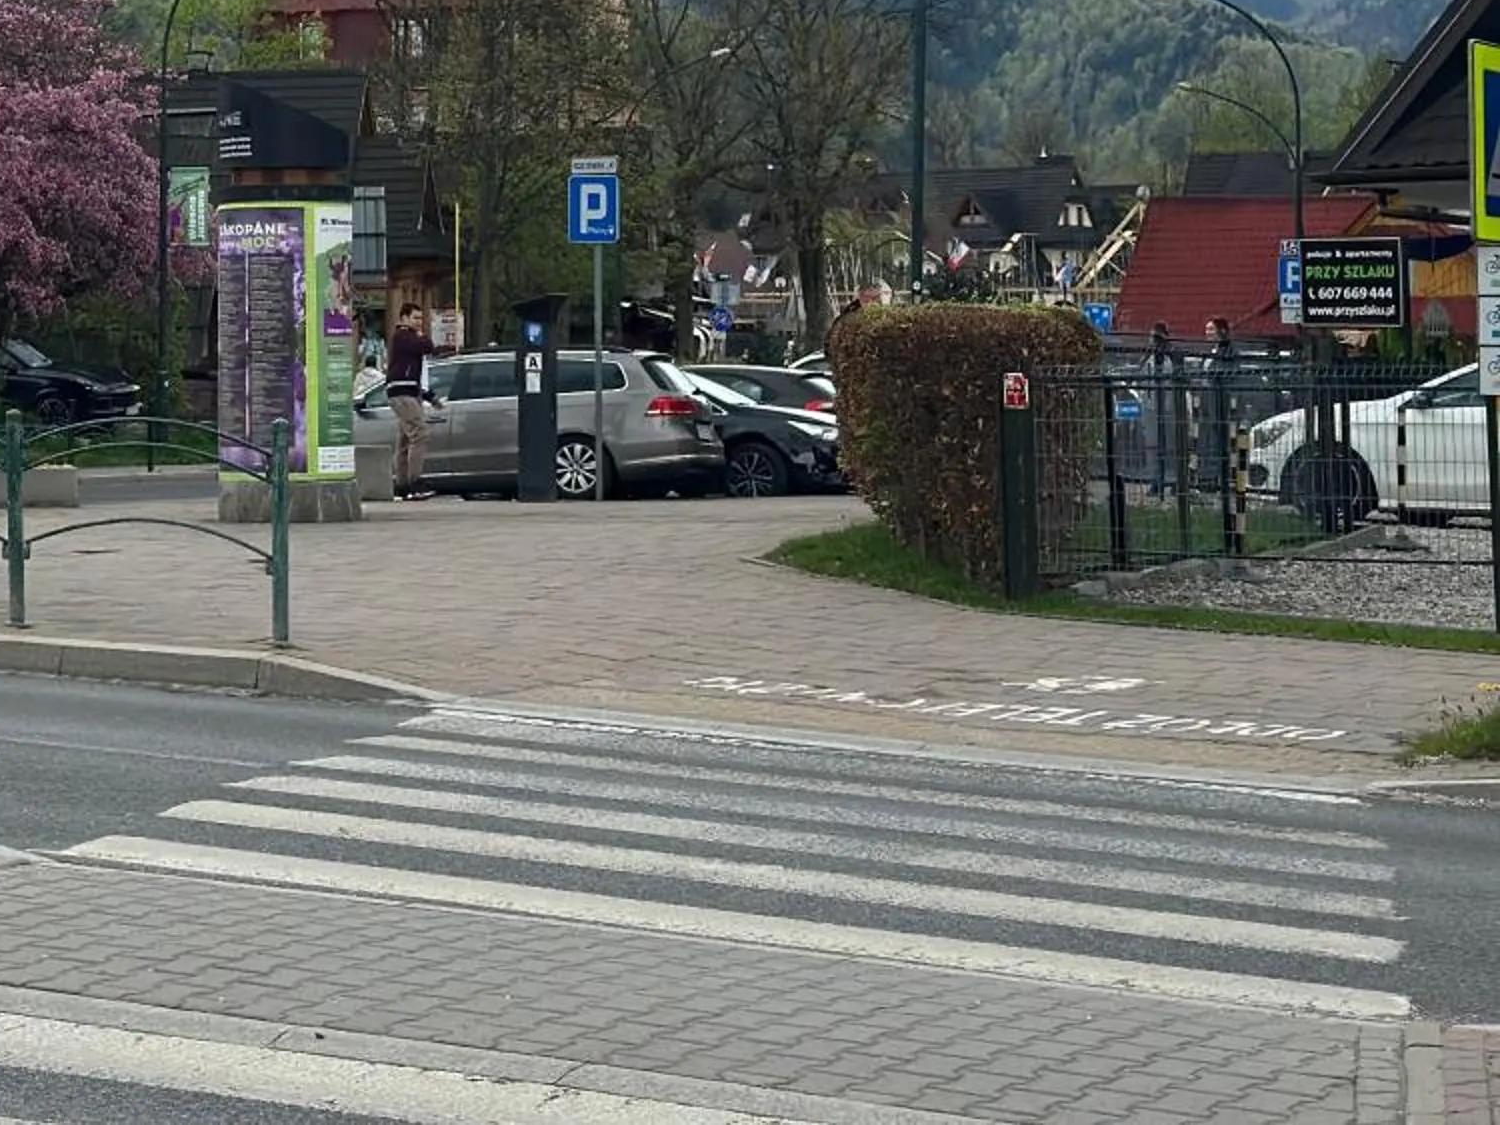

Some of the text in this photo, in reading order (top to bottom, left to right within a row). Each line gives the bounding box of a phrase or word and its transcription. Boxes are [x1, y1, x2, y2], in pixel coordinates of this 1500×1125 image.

[580, 183, 607, 234] P
[1305, 263, 1395, 280] PRZY SZLAKU
[1318, 286, 1393, 300] 607 669 444
[1307, 304, 1396, 318] www.przyszlaku.pl
